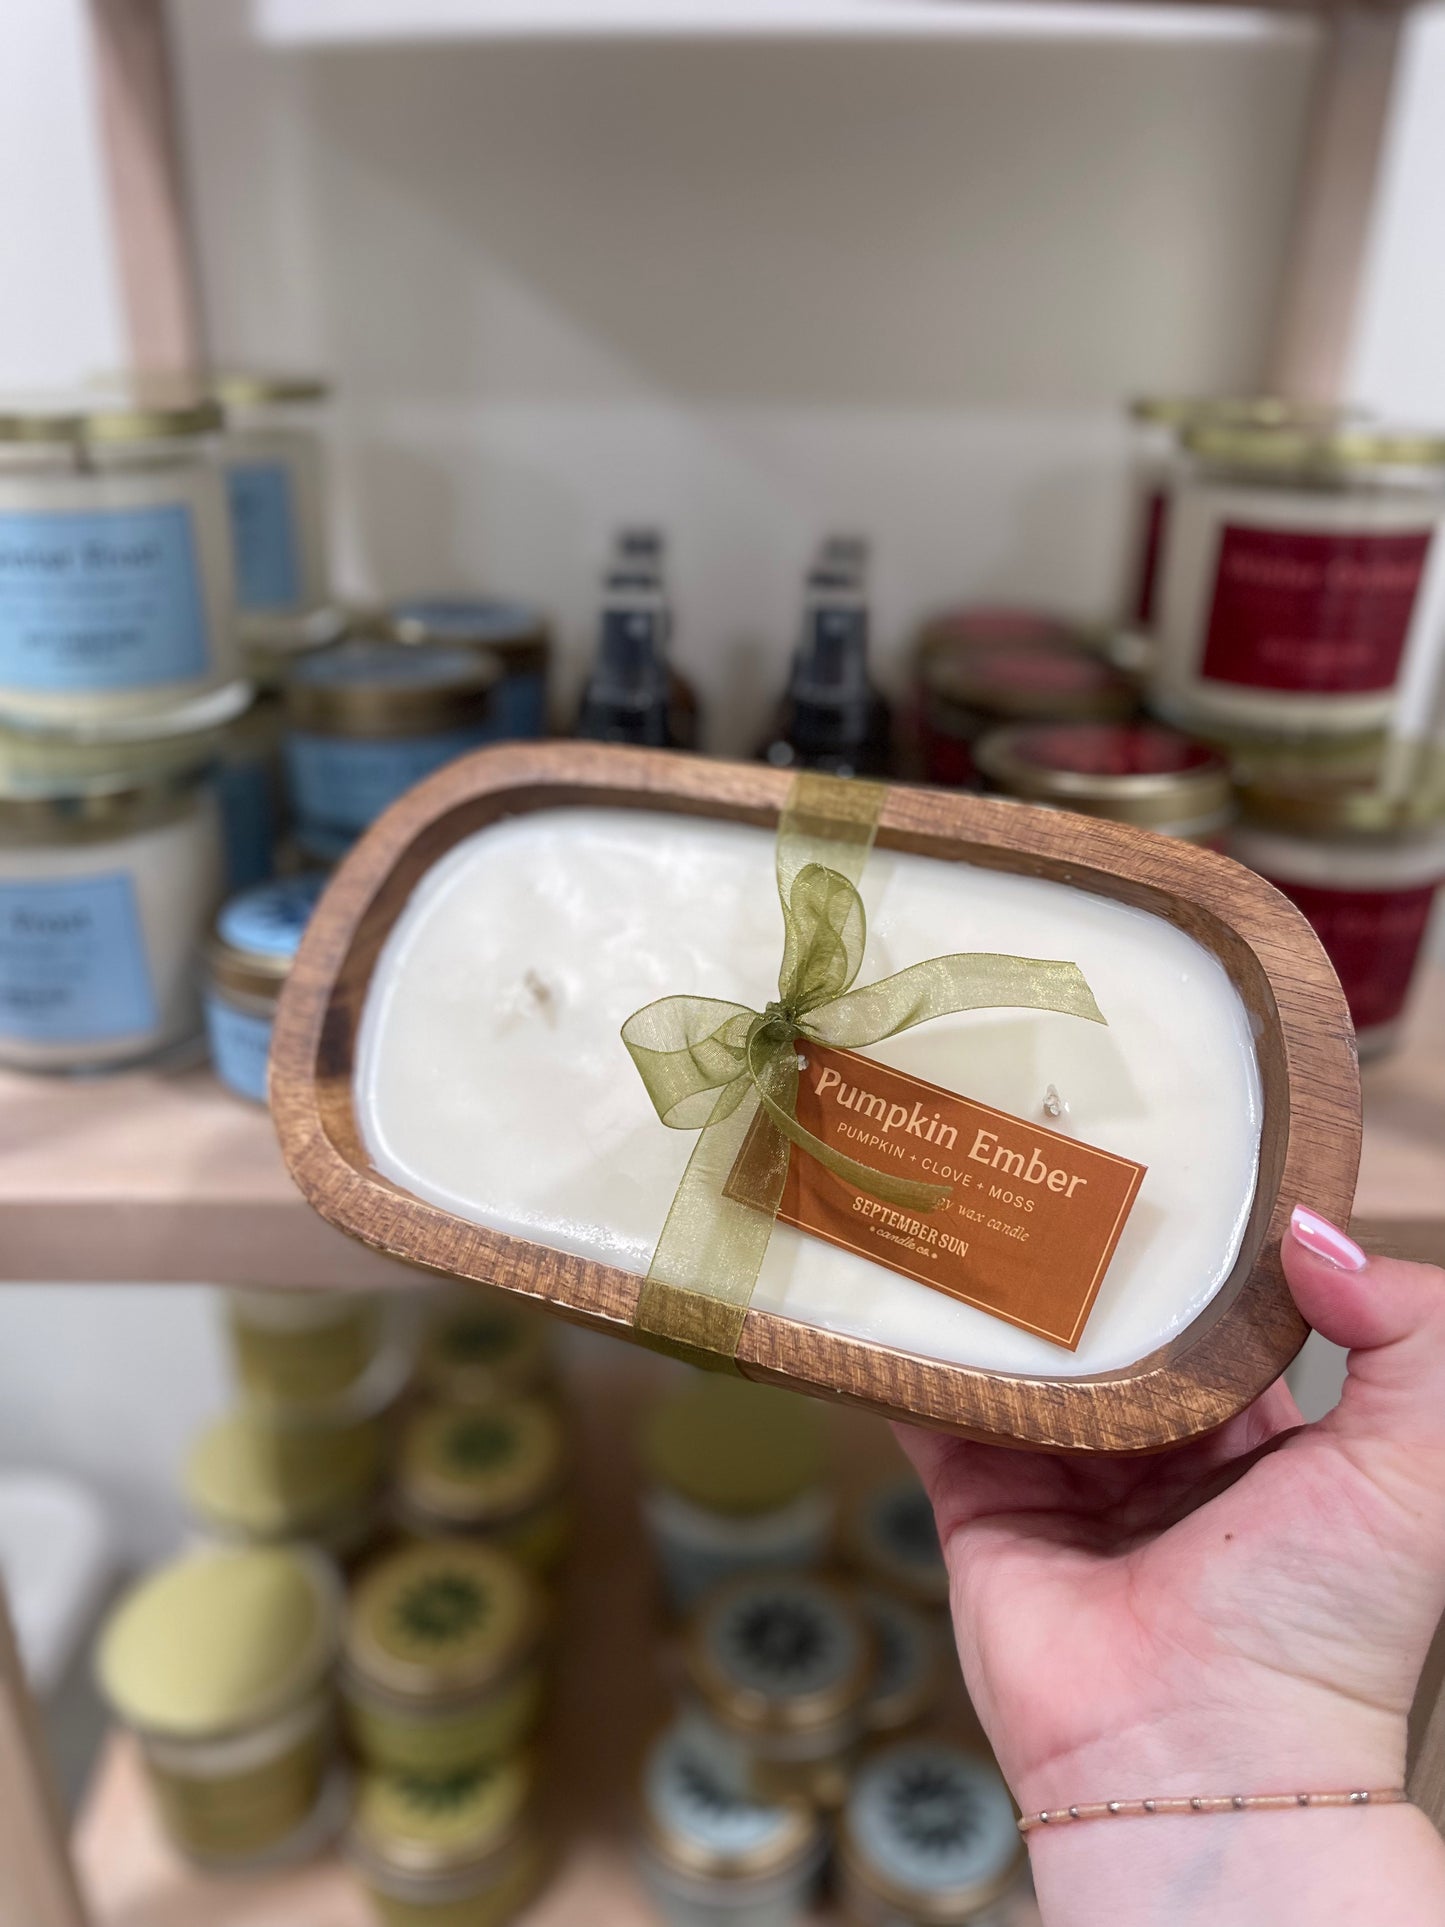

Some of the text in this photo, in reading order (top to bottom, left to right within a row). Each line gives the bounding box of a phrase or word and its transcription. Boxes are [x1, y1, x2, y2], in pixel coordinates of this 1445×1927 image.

[814, 1067, 1088, 1199] Pumpkin Ember
[837, 1122, 906, 1160] PUMPKIN
[921, 1157, 973, 1188] CLOVE
[988, 1184, 1036, 1213] MOSS
[852, 1196, 970, 1258] SEPTEMBER SUN
[876, 1228, 917, 1250] candle
[958, 1203, 986, 1223] wax
[987, 1217, 1031, 1243] candle
